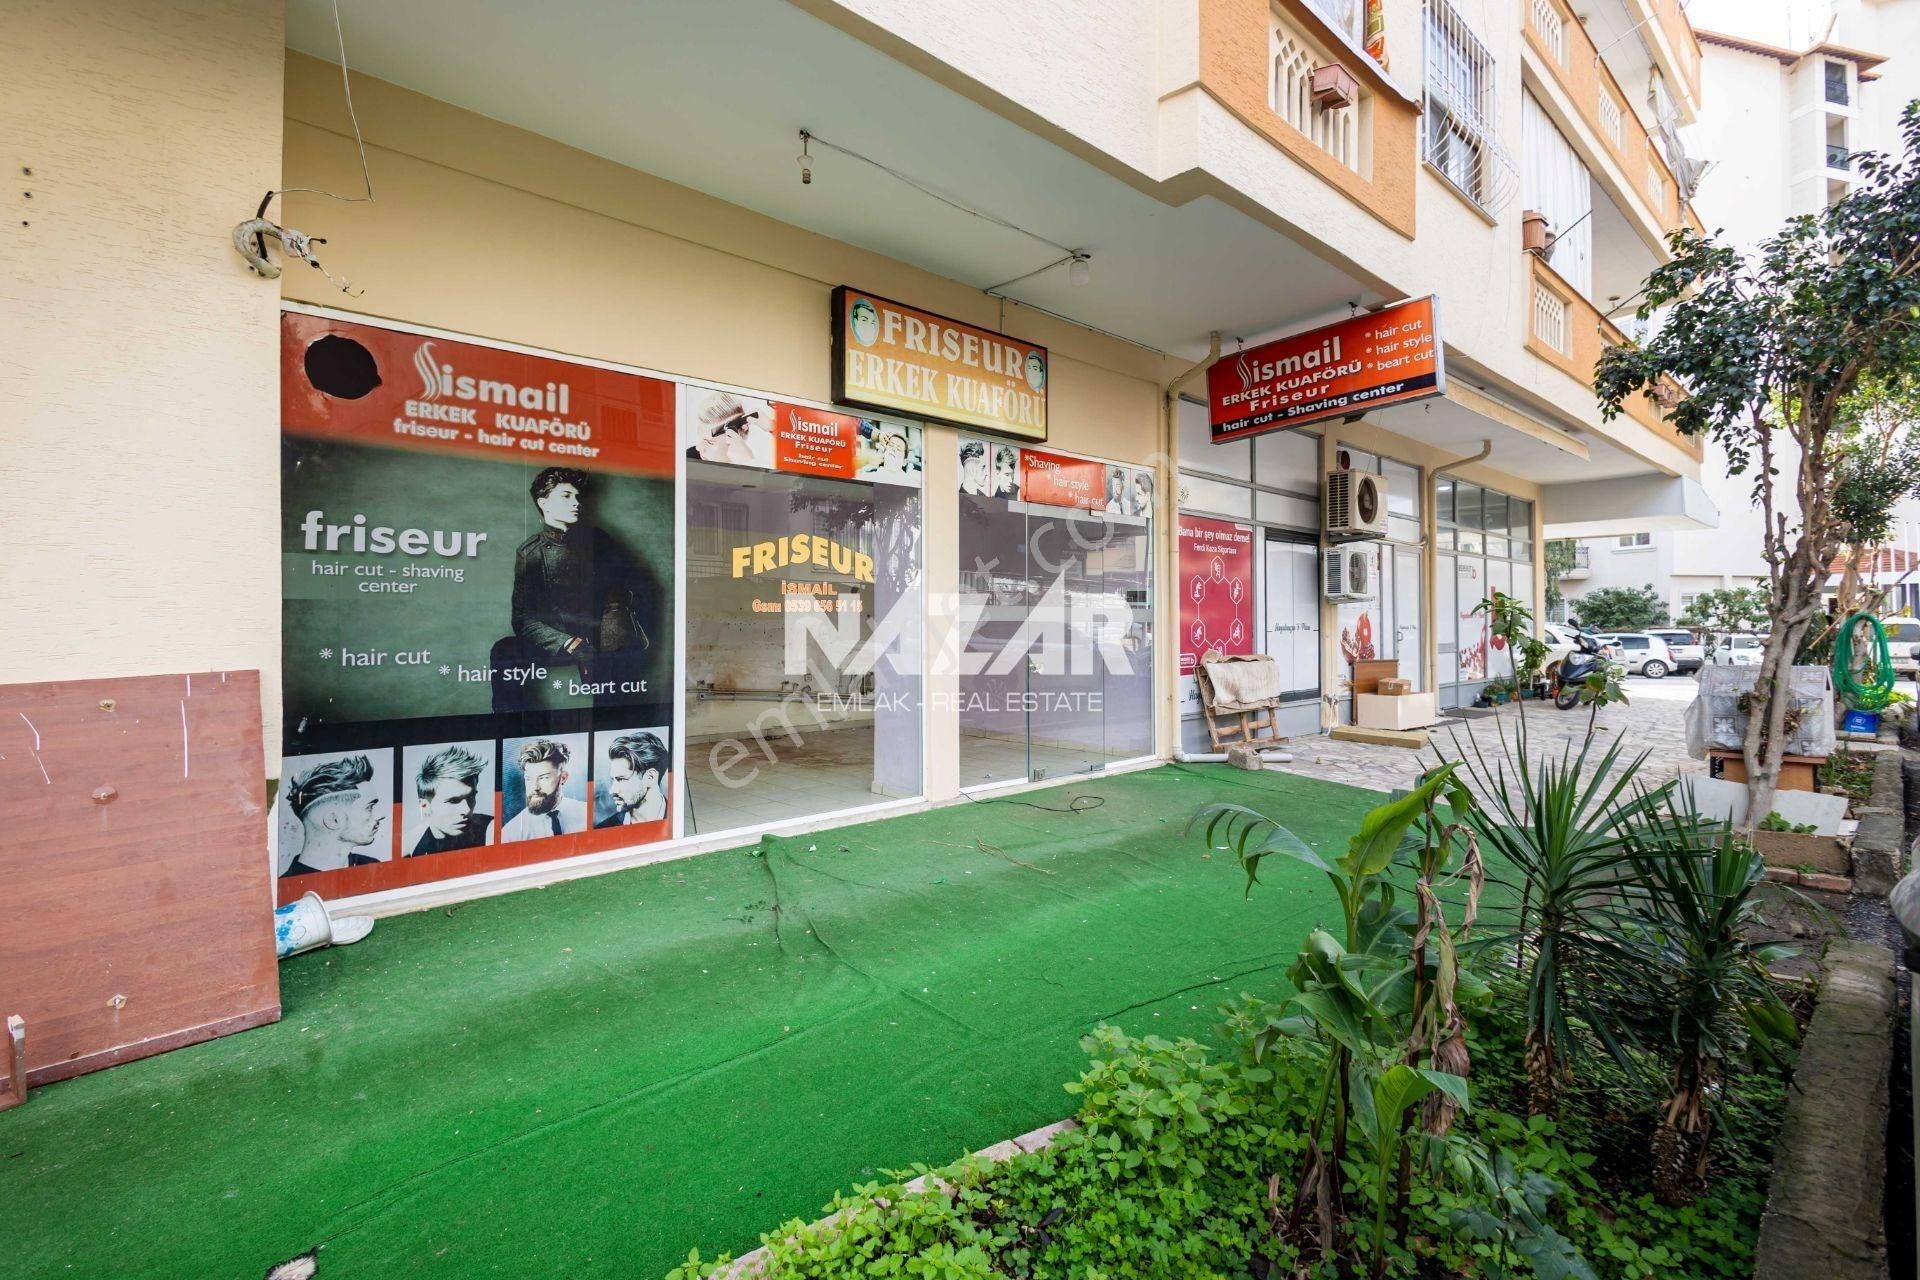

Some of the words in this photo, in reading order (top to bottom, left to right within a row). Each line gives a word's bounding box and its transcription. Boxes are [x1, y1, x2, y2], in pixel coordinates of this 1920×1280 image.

[1375, 327, 1399, 340] hair
[1402, 320, 1423, 332] cut
[883, 309, 1023, 380] FRISEUR
[1376, 342, 1399, 355] hair
[1403, 333, 1433, 349] style
[1252, 335, 1341, 383] ismail
[1377, 355, 1410, 371] beart
[1414, 350, 1435, 361] cut
[442, 363, 569, 414] ismail
[848, 349, 940, 404] ERKEK
[946, 373, 1046, 427] KUAFÖRÜ
[1222, 385, 1271, 407] ERKEK
[1276, 360, 1362, 393] KUAFÖRÜ
[1223, 418, 1249, 432] hair
[1253, 412, 1273, 424] cut
[1287, 396, 1348, 418] Shaving
[1352, 382, 1404, 402] center
[1250, 384, 1330, 412] Friseur
[405, 400, 477, 425] ERKEK
[495, 411, 591, 441] KUAFÖRÜ
[797, 416, 838, 437] ismail
[393, 418, 460, 440] friseur
[478, 428, 516, 447] hair
[520, 437, 545, 451] cut
[548, 441, 600, 458] center
[780, 431, 806, 442] ERKEK
[808, 436, 846, 448] KUAFÖRÜ
[795, 441, 833, 453] Friseur
[783, 456, 817, 467] Shaving
[818, 460, 844, 470] center
[798, 453, 815, 461] hair
[1053, 476, 1068, 488] hair
[1071, 480, 1089, 492] style
[1075, 492, 1089, 505] hair
[300, 510, 488, 557] friseur
[1178, 526, 1194, 537] Bana
[1195, 527, 1203, 538] bir
[1204, 529, 1215, 541] şey
[1215, 530, 1233, 541] olmaz
[732, 533, 875, 583] FRISEUR
[312, 561, 349, 576] hair
[354, 563, 384, 577] cut
[402, 563, 465, 582] shaving
[358, 579, 418, 594] center
[341, 647, 388, 667] hair
[394, 647, 431, 666] cut
[457, 665, 497, 682] hair
[502, 662, 548, 687] style
[568, 679, 616, 696] beart
[620, 678, 648, 694] cut
